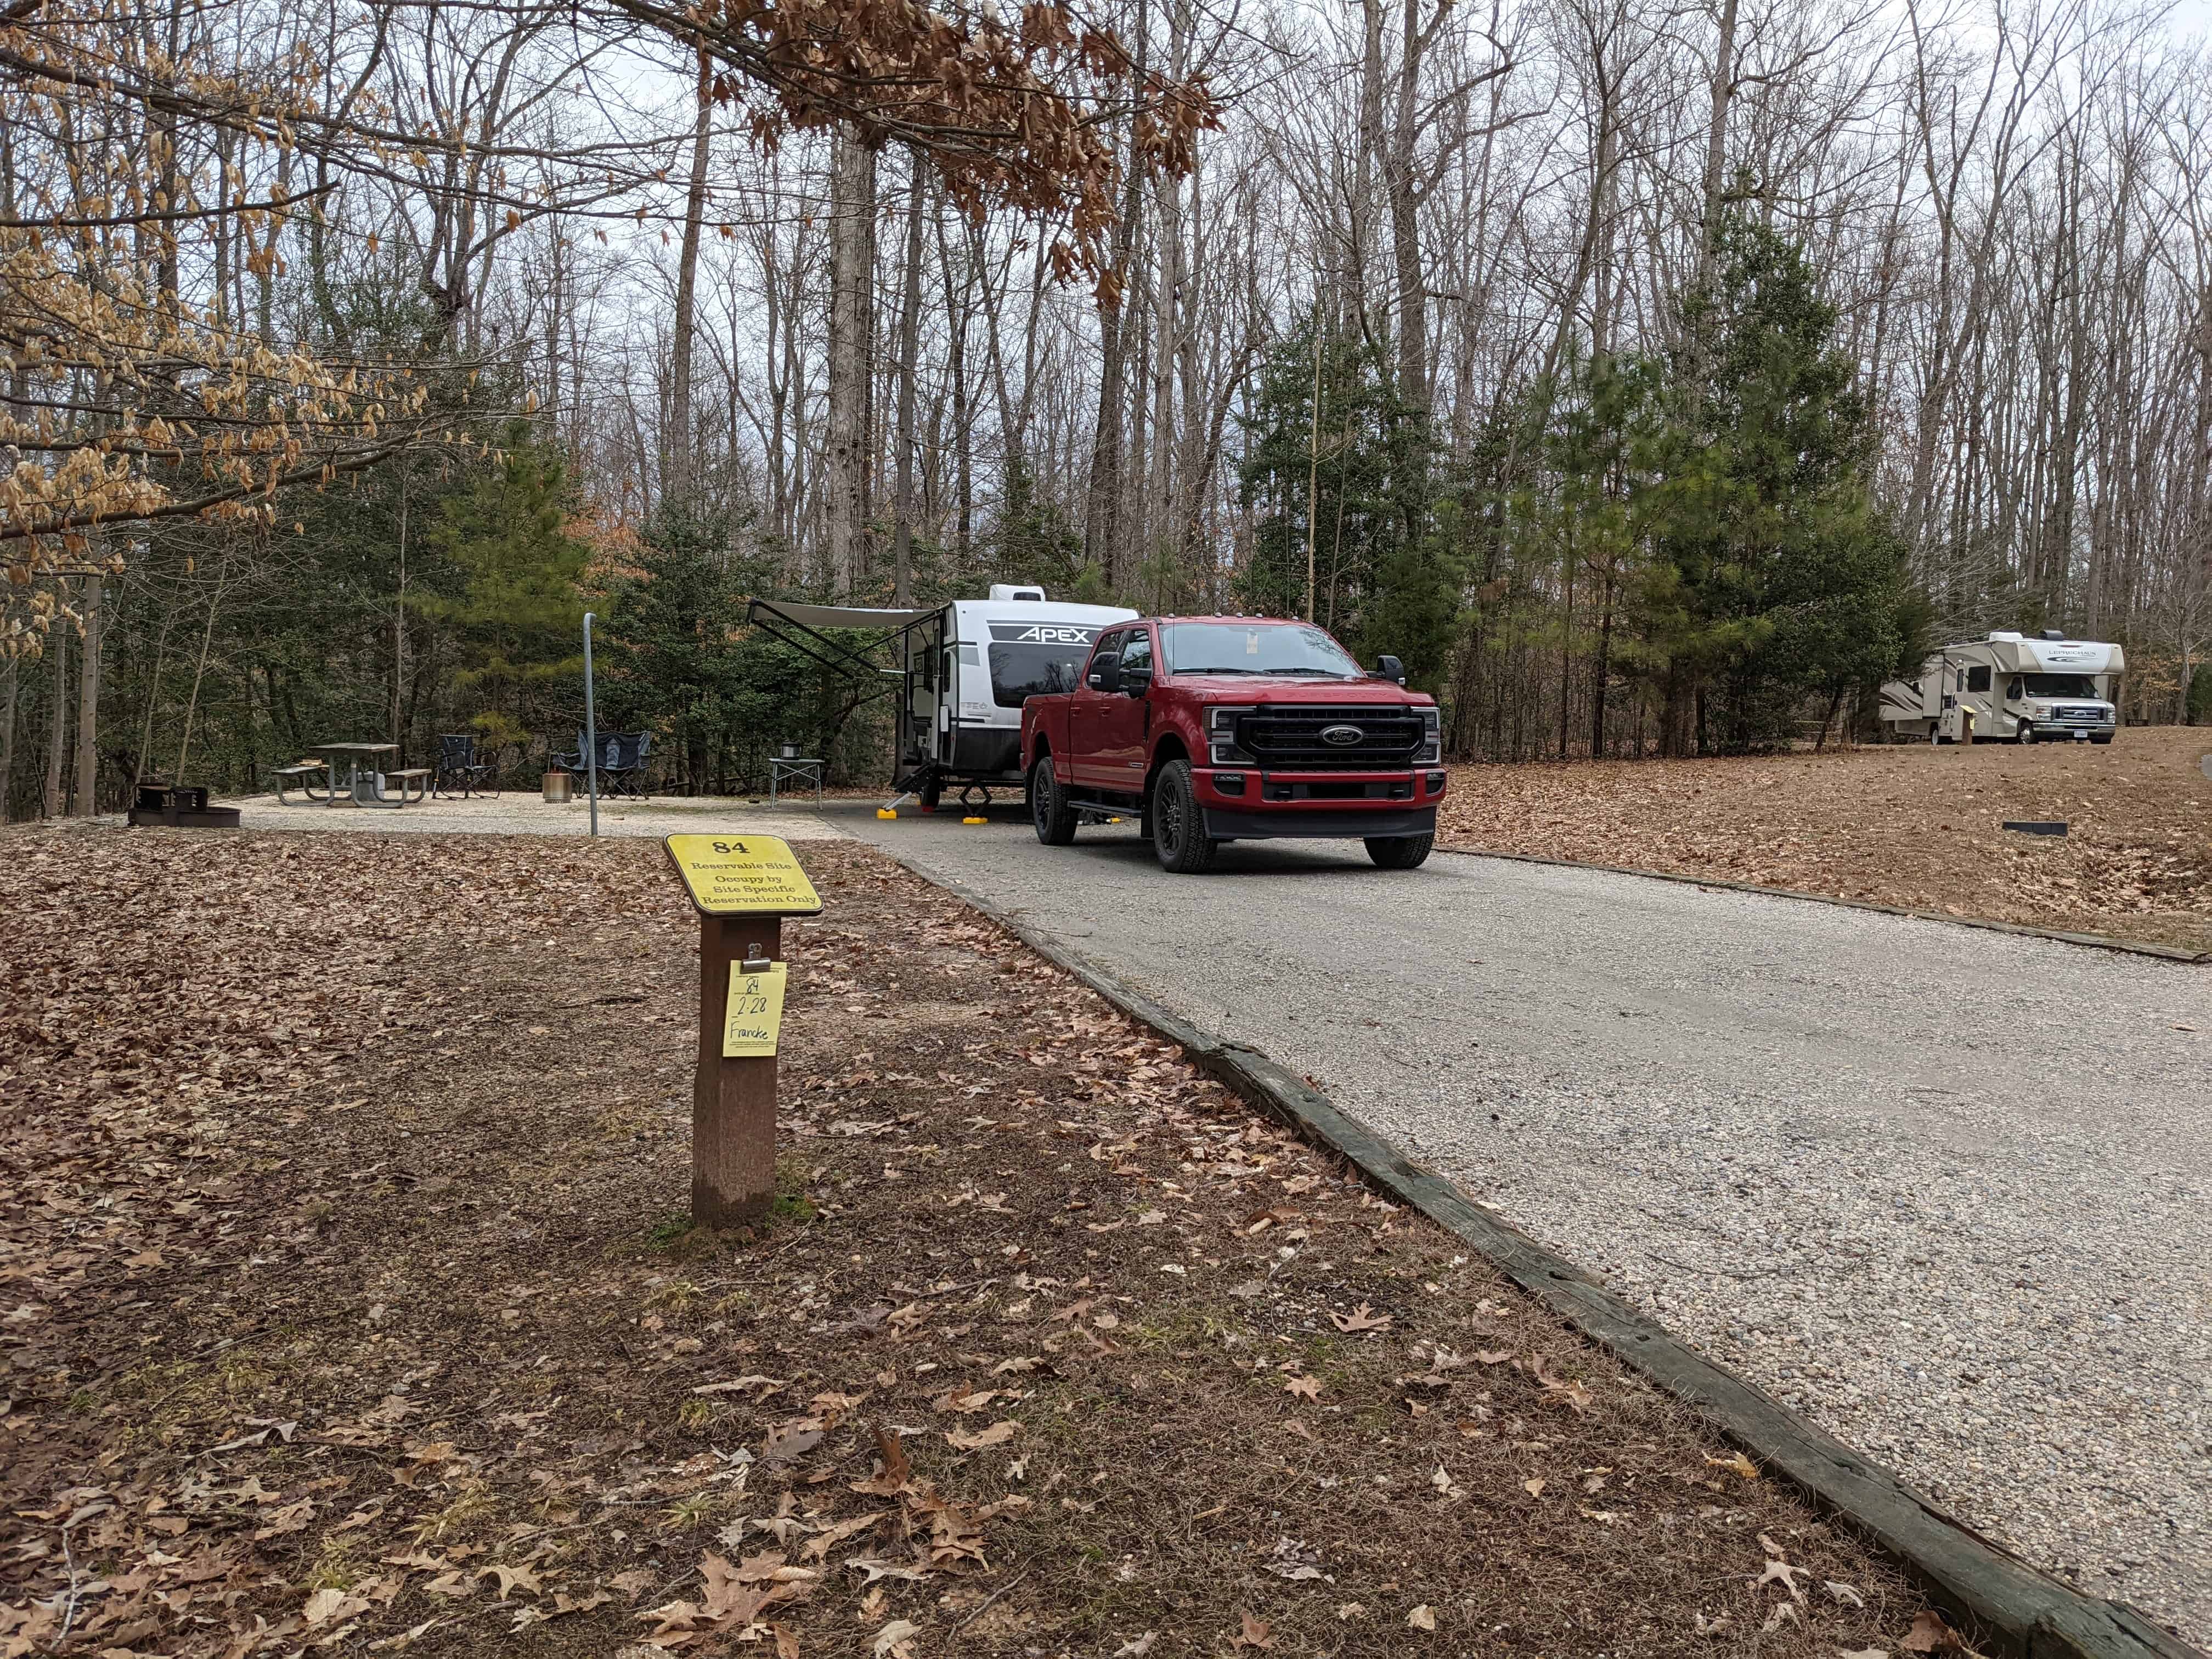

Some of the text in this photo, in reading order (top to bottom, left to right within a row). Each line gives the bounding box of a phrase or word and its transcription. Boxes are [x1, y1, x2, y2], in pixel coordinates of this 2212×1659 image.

[1017, 627, 1090, 643] APEX
[1332, 731, 1354, 741] Ford
[712, 842, 751, 854] 84
[743, 885, 795, 894] Specific
[786, 895, 816, 904] Only
[747, 978, 759, 994] 84
